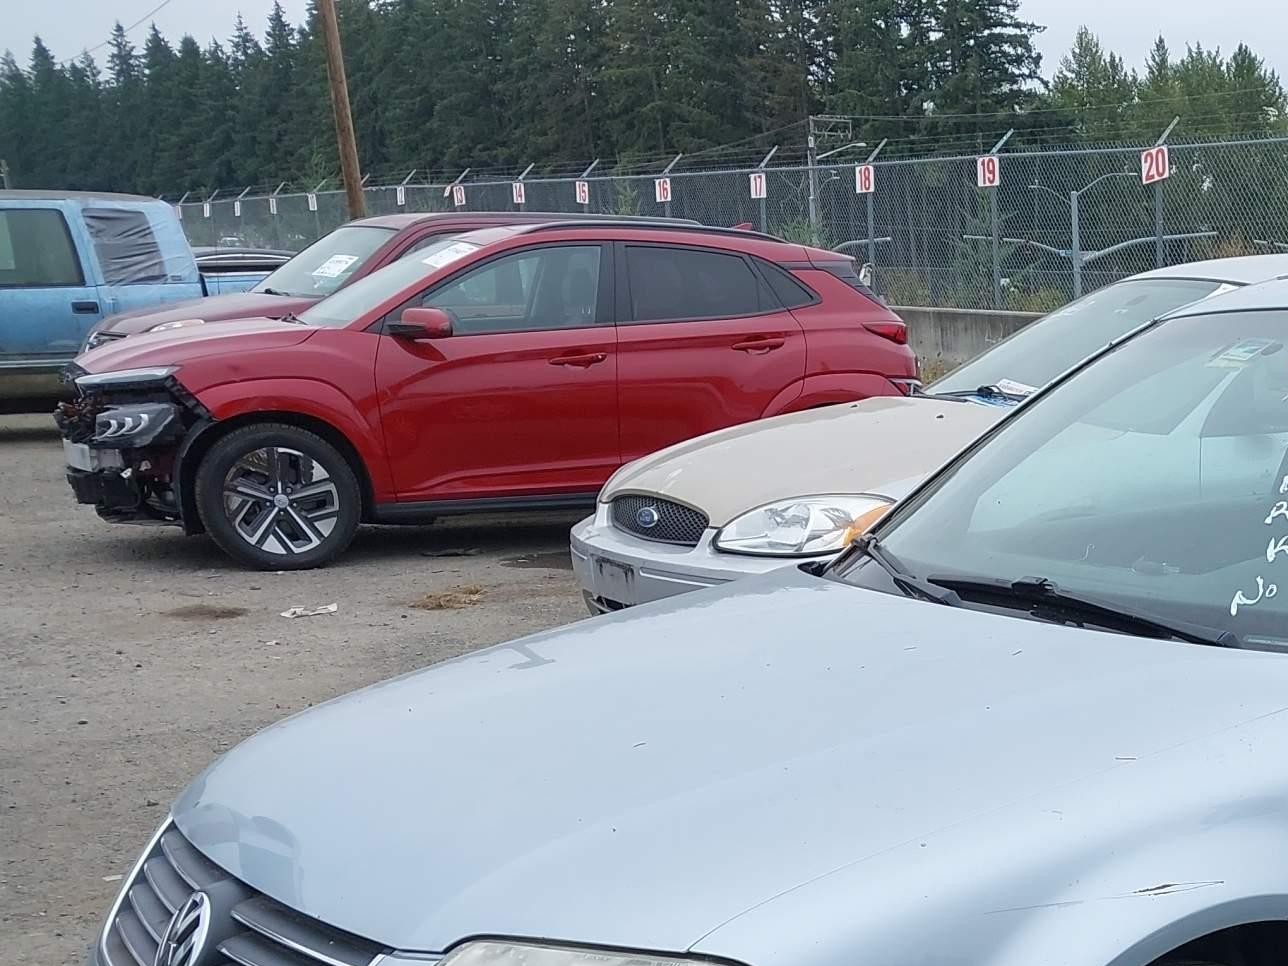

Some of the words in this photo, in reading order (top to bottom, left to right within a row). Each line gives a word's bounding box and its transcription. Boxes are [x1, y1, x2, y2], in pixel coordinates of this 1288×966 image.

[981, 157, 996, 185] 19
[1144, 147, 1166, 183] 20
[657, 180, 669, 201] 16
[752, 174, 763, 197] 17
[858, 166, 871, 192] 18
[514, 183, 523, 202] 14
[578, 183, 587, 202] 15
[1230, 574, 1278, 617] No
